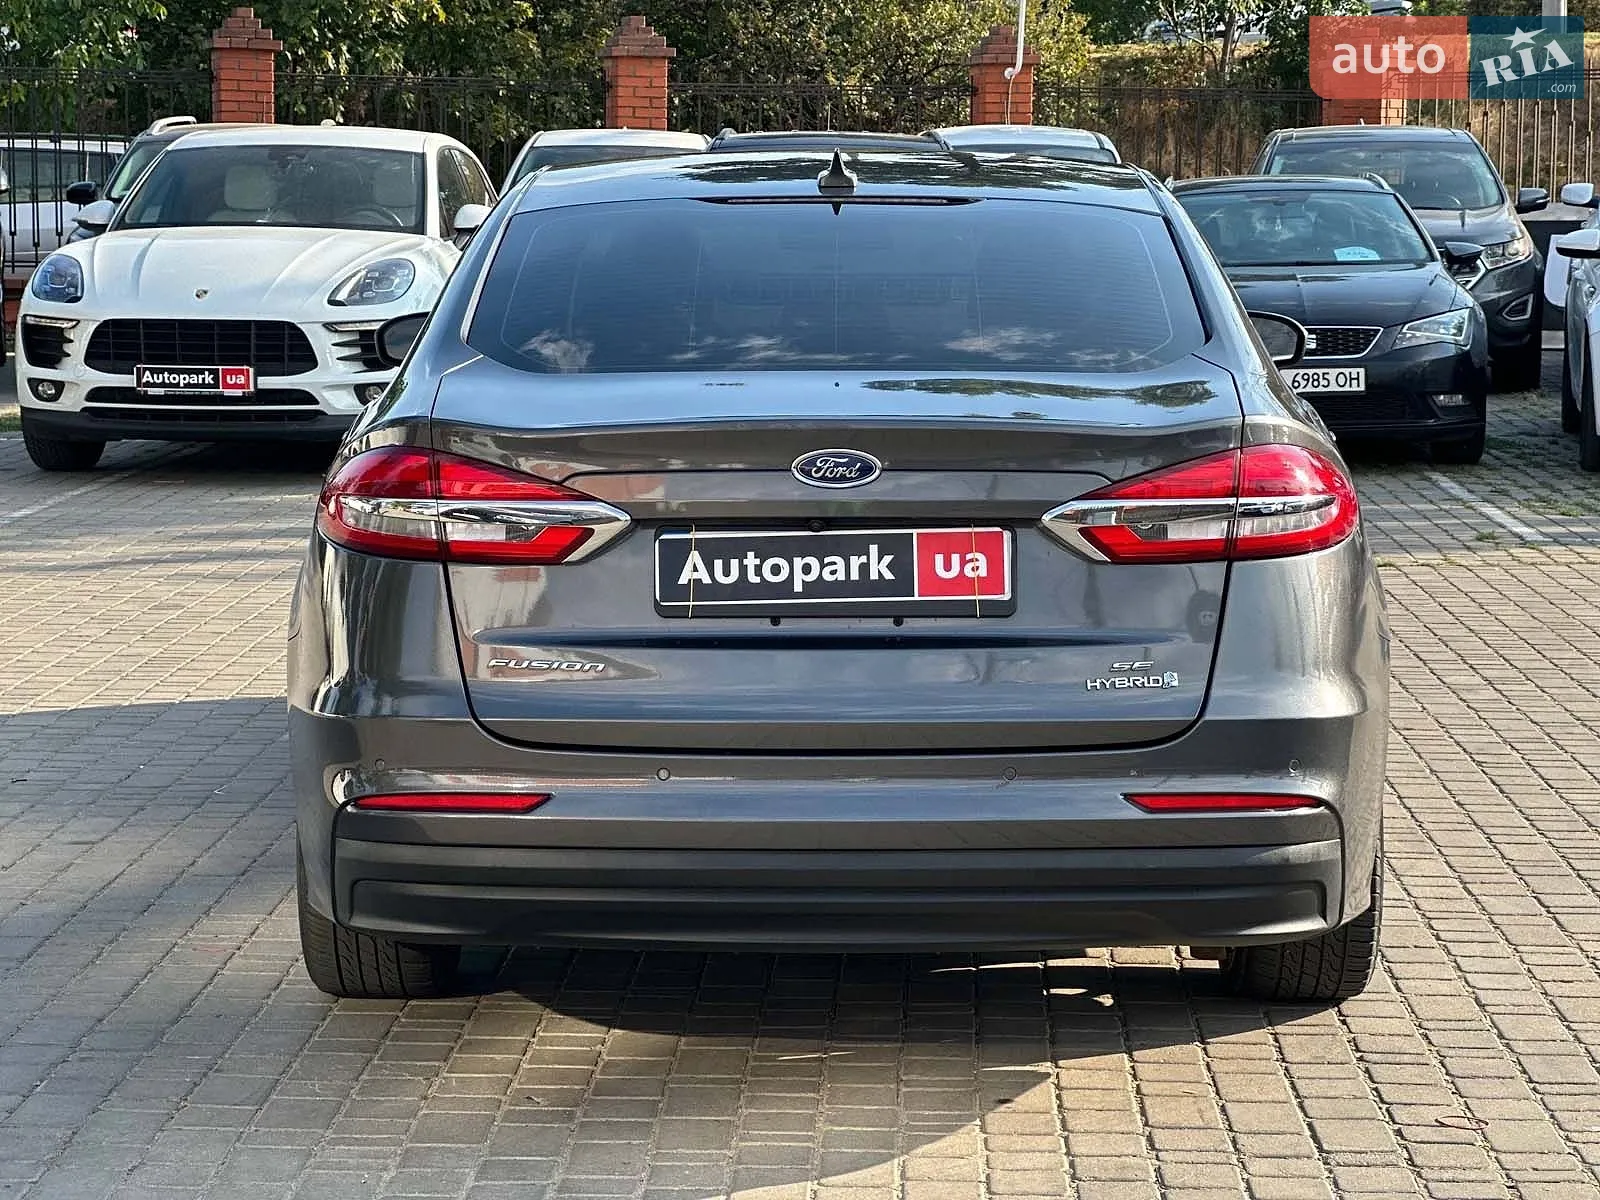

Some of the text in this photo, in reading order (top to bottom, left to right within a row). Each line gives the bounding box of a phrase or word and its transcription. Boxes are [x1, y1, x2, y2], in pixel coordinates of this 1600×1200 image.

[142, 370, 245, 387] Autopark ua
[1291, 371, 1360, 389] 6985 OH
[811, 457, 862, 478] Ford
[677, 544, 989, 593] Autopark ua
[488, 658, 606, 673] FUSION
[1110, 660, 1154, 672] SE
[1086, 675, 1163, 691] HYBRID
